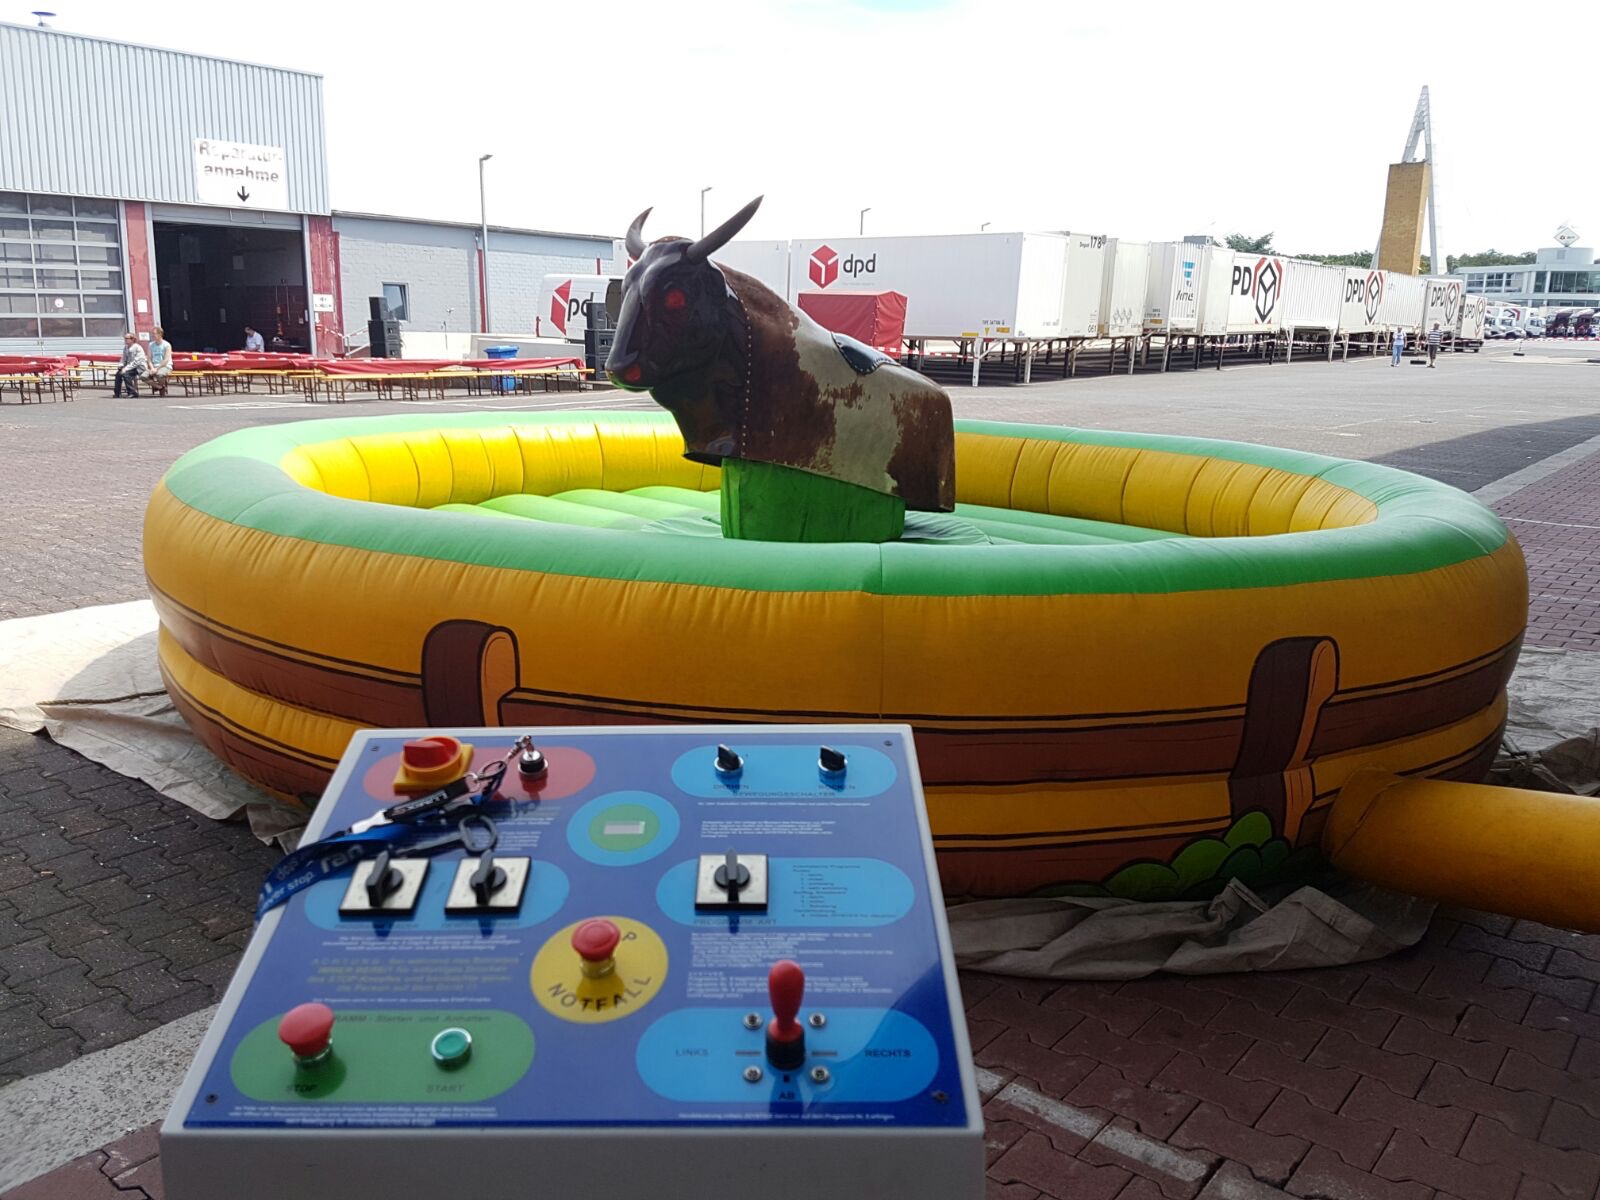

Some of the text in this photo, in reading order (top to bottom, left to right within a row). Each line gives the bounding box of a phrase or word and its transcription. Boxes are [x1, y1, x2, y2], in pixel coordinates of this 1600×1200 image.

[203, 165, 280, 183] annahme
[1090, 236, 1102, 249] 178
[843, 253, 876, 278] dpd
[1231, 265, 1252, 295] PD
[1345, 278, 1364, 303] DPD
[1430, 286, 1447, 308] DPD
[548, 976, 652, 1012] NOTFALL
[675, 1048, 709, 1057] LINKS
[864, 1049, 911, 1057] RECHTS
[285, 1084, 318, 1093] STOP
[425, 1084, 464, 1093] START
